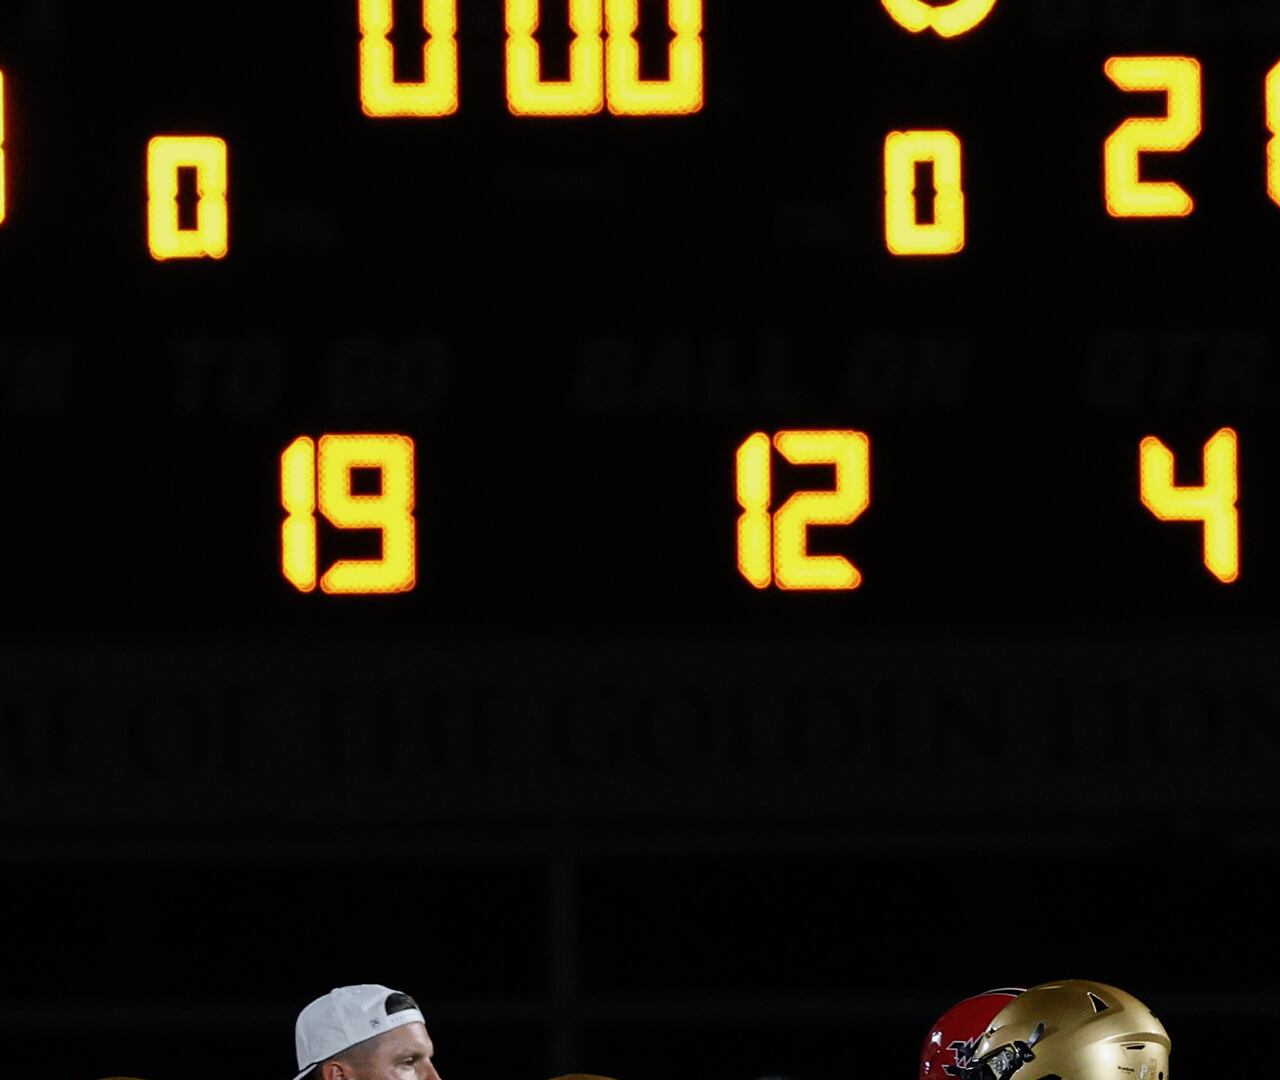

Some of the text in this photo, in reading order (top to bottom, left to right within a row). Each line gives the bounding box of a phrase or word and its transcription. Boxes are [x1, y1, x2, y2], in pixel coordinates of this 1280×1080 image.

[146, 135, 229, 262] 0
[883, 129, 966, 256] 0
[172, 335, 448, 413] TO GO
[576, 332, 970, 410] BALL ON
[280, 433, 417, 594] 19
[735, 429, 871, 591] 12
[1139, 427, 1240, 583] 4
[120, 684, 276, 784] OF
[300, 682, 520, 782] THE
[546, 674, 1010, 778] GOLDEN
